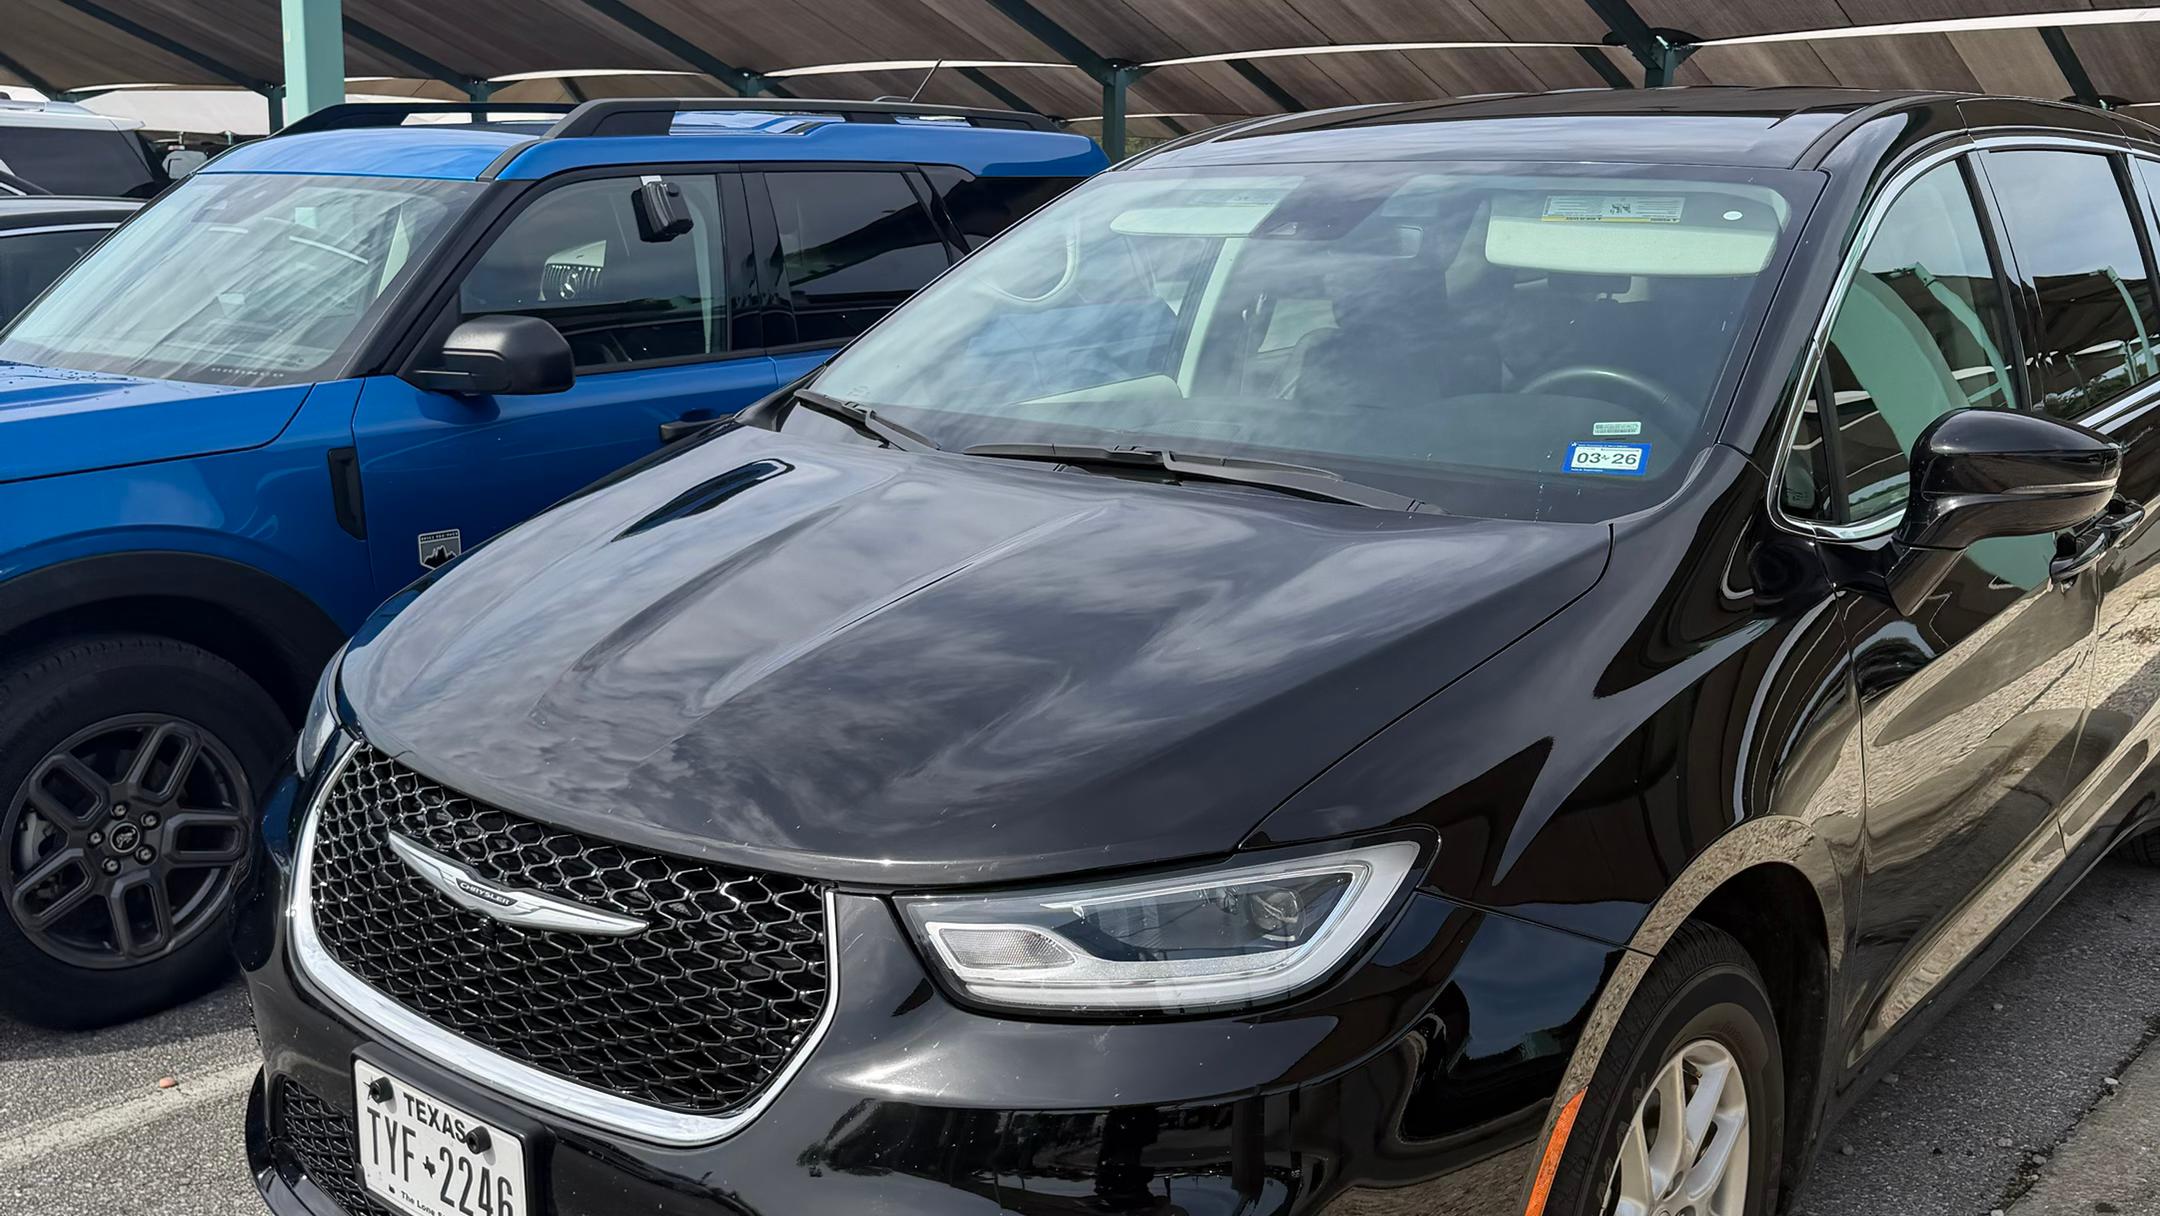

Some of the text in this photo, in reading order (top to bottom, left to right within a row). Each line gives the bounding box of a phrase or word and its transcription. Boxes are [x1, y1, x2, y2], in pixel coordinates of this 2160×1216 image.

[1576, 452, 1638, 465] 03 26
[460, 882, 511, 905] CHRYSLER
[403, 1092, 466, 1144] TEXAS
[367, 1106, 514, 1216] TYF 2246
[401, 1190, 415, 1204] The
